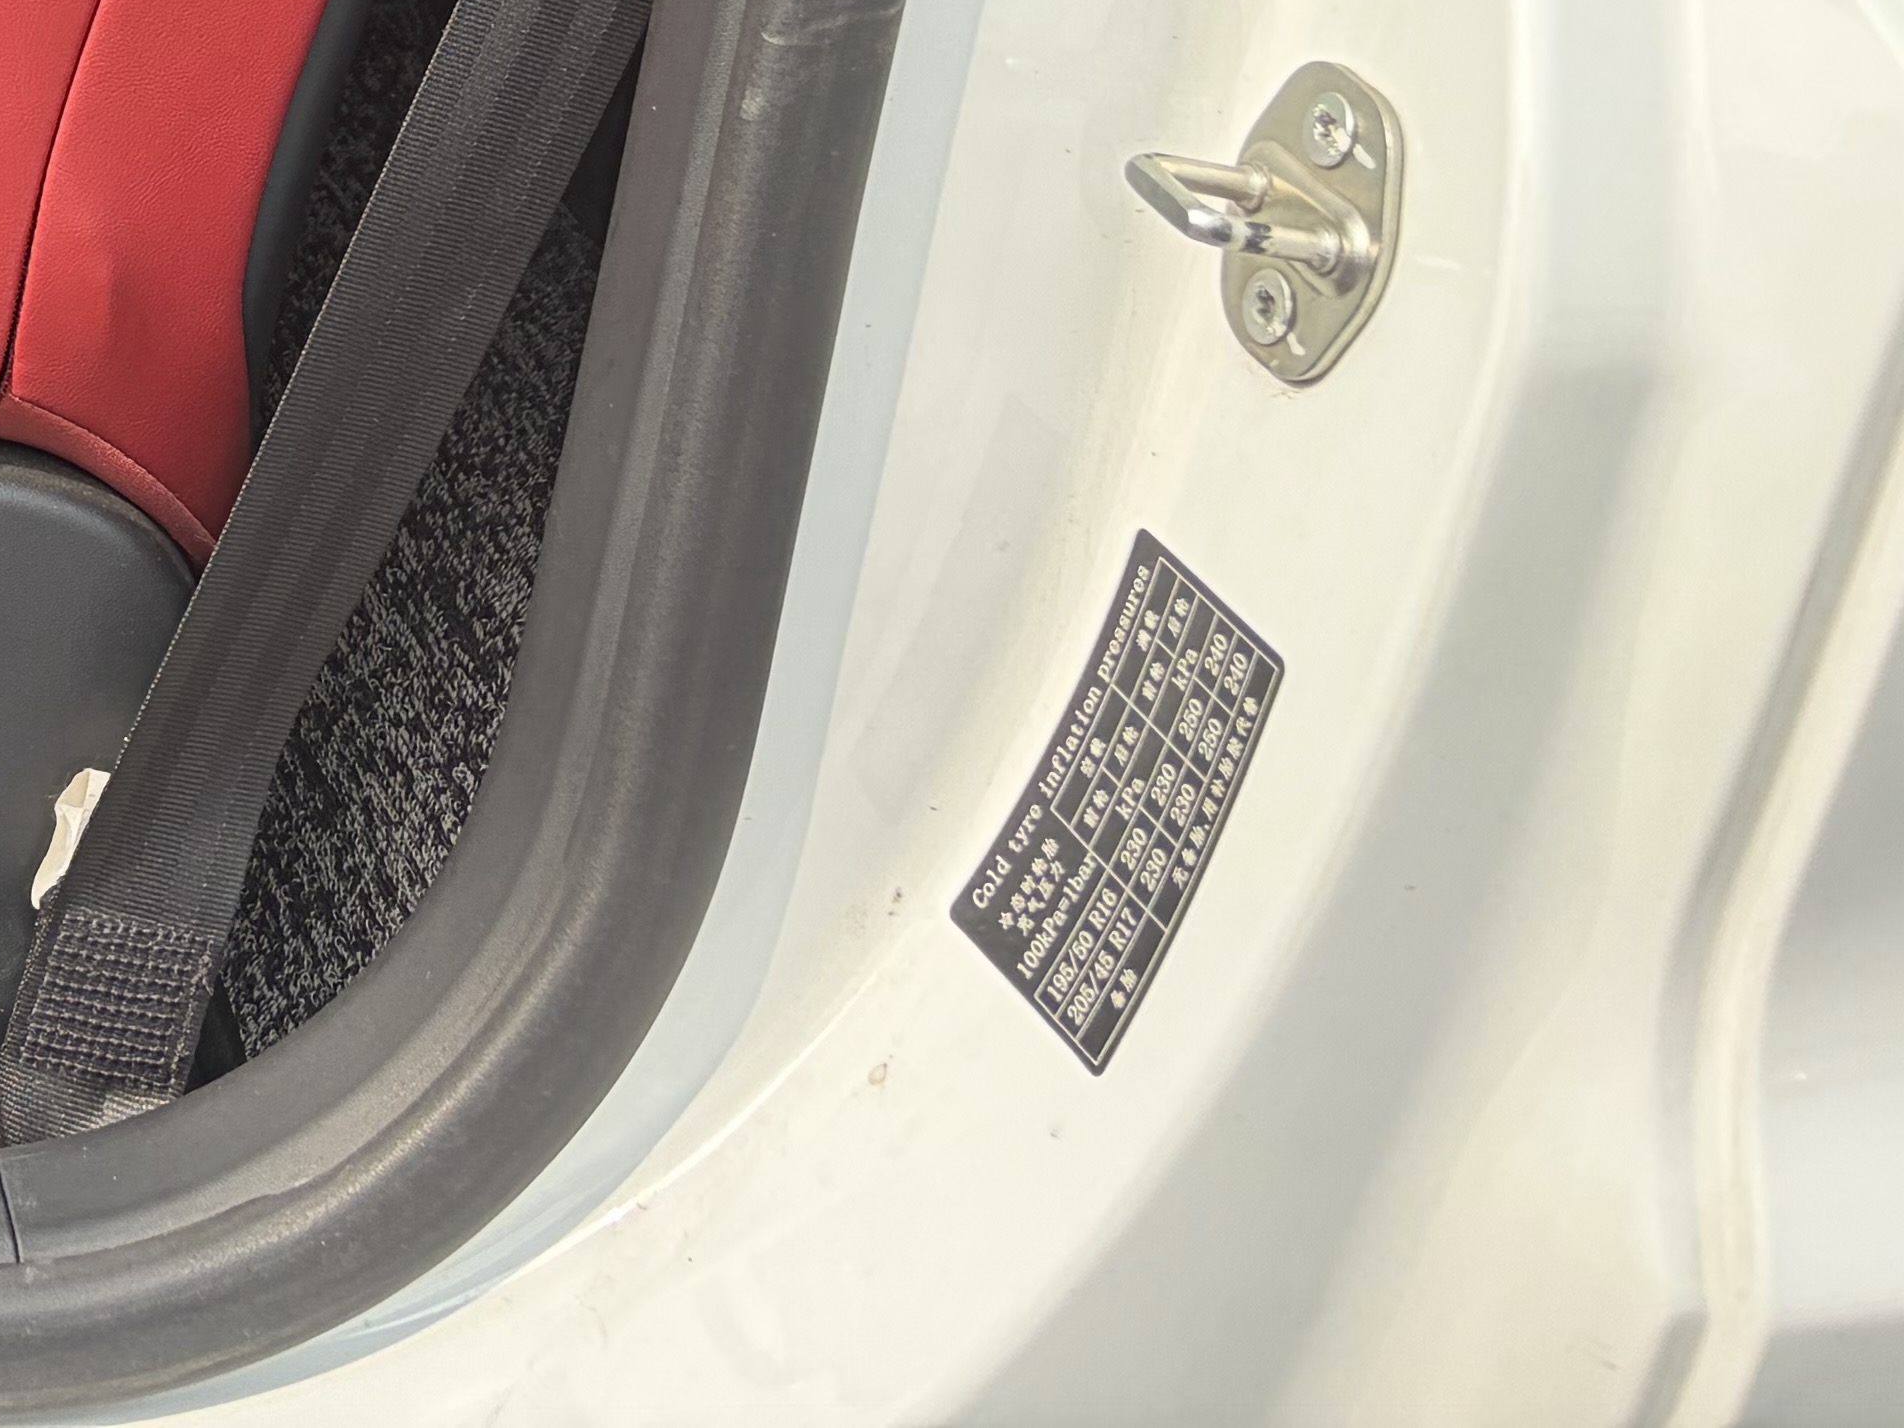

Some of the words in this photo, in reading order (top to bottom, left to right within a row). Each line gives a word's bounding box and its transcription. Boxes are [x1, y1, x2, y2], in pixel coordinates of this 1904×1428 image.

[1047, 931, 1093, 1001] 195/50
[1088, 888, 1116, 930] R16
[1121, 828, 1146, 870] 230
[1151, 764, 1176, 806] 230
[1179, 699, 1202, 741] 250
[1205, 634, 1227, 676] 240
[1115, 778, 1144, 820] kPa
[1172, 649, 1198, 691] kPa
[973, 855, 1011, 908] Cold
[1017, 850, 1100, 979] 100kPa=1bar
[1067, 950, 1114, 1025] 205/45
[1109, 907, 1136, 951] R17
[1140, 849, 1166, 891] 230
[1171, 784, 1195, 826] 230
[1198, 719, 1222, 761] 250
[1224, 653, 1247, 695] 240
